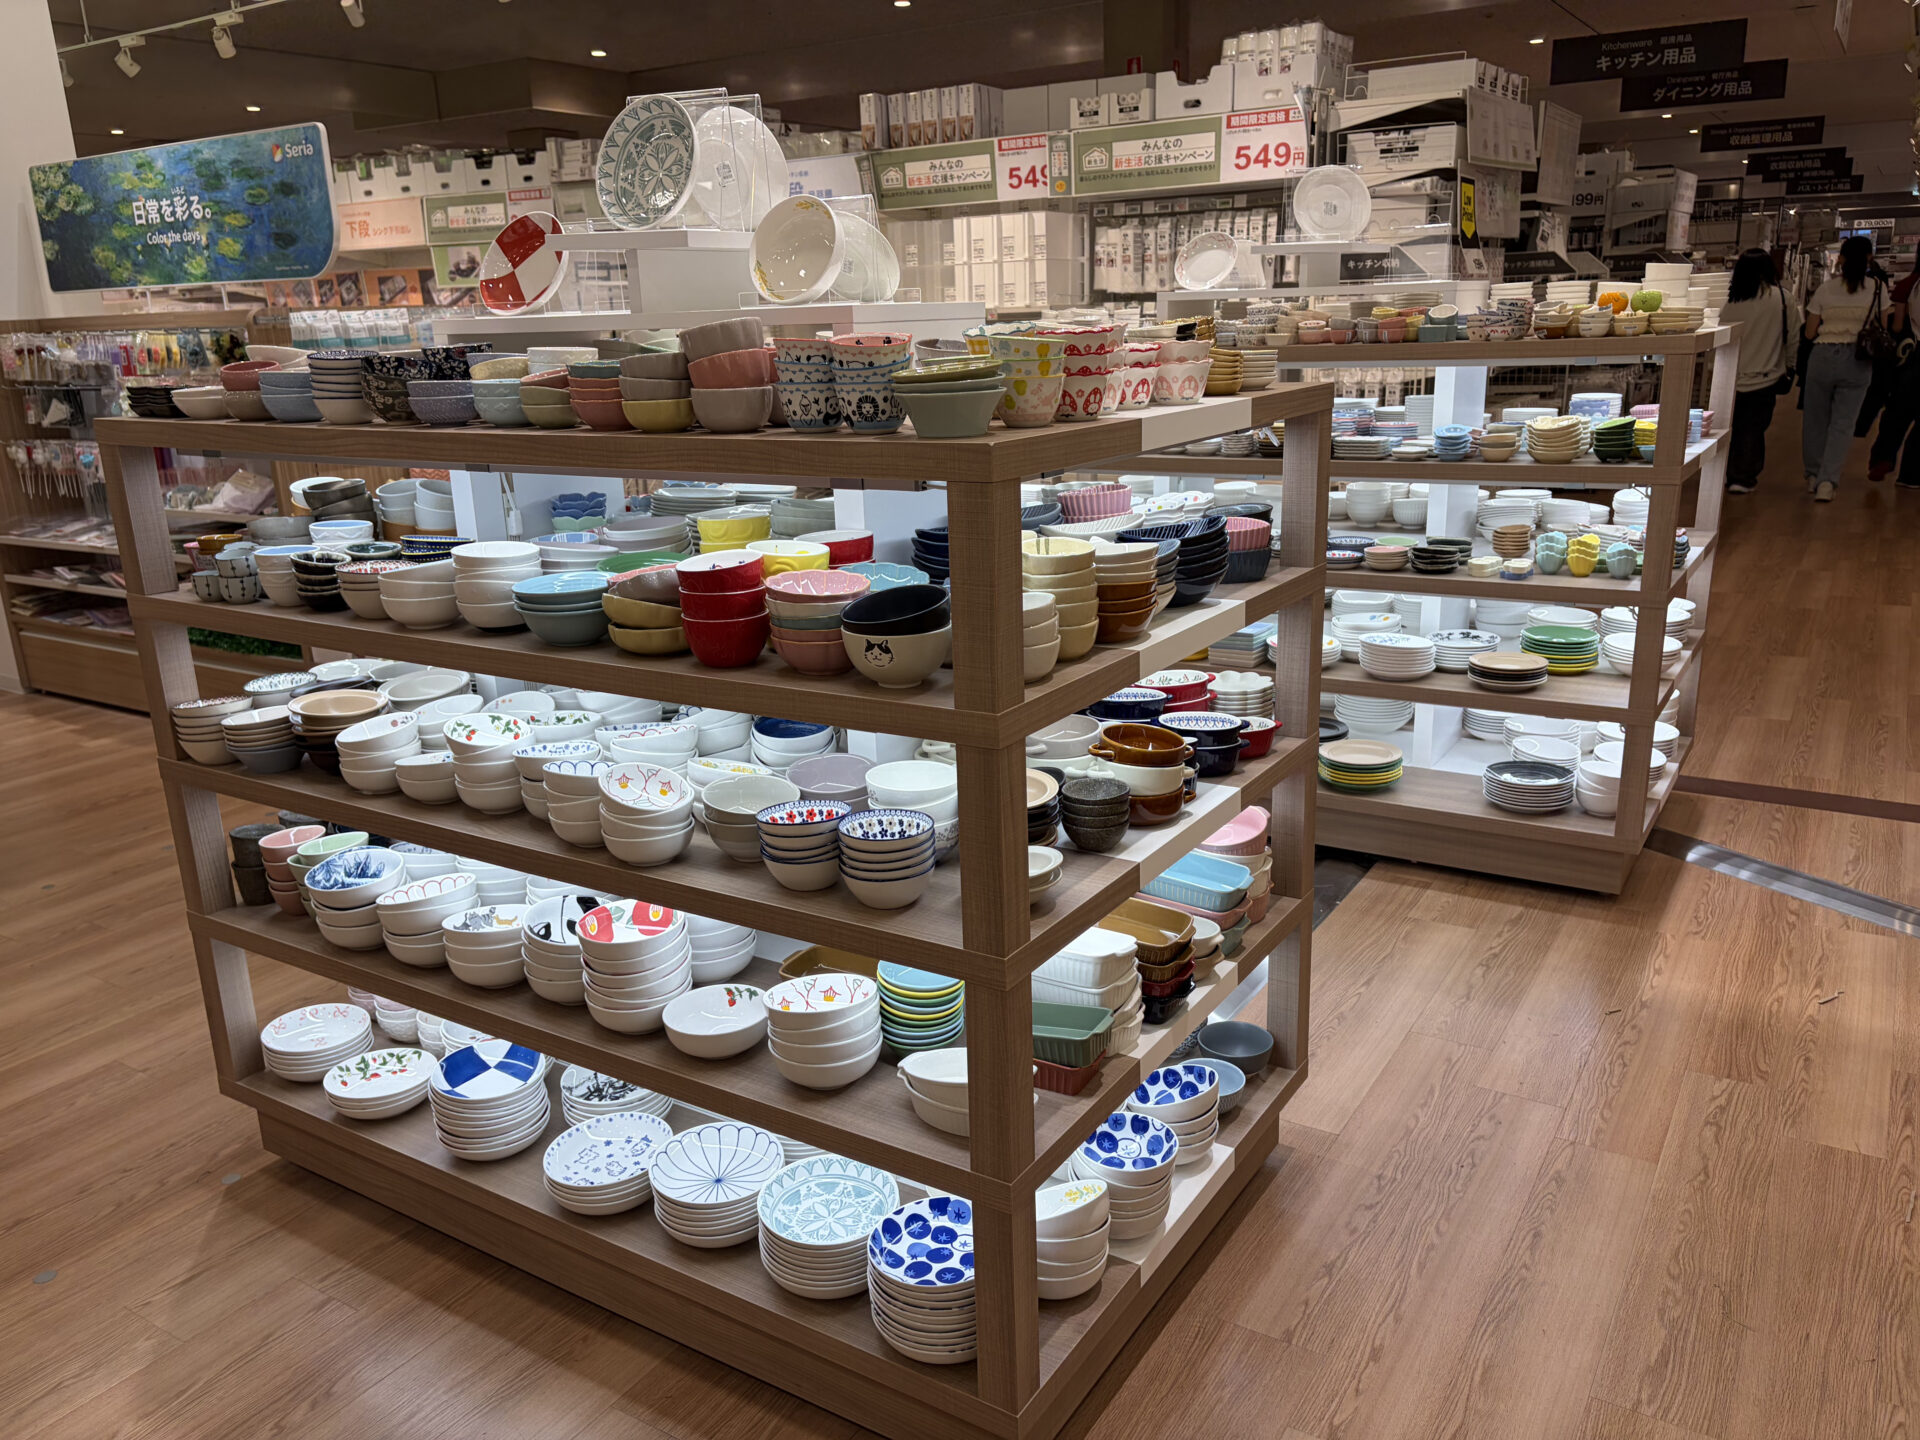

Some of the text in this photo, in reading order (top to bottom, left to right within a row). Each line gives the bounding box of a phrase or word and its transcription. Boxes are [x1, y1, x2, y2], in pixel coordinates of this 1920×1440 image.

[1602, 39, 1653, 51] Kitchenware
[1596, 46, 1697, 72] キッチン用品
[1652, 80, 1753, 102] ダイニング用品
[1230, 110, 1287, 128] 期間限定価格
[284, 140, 314, 158] Seria
[1141, 138, 1183, 152] みんなの
[929, 159, 964, 172] みんなの
[1114, 150, 1214, 169] 新生活応援キャンペーン
[908, 170, 990, 187] 新生活応援キャンペーン
[132, 195, 212, 226] 日常を彩る。
[146, 232, 166, 246] Color
[167, 229, 182, 243] the
[345, 219, 371, 239] 下段
